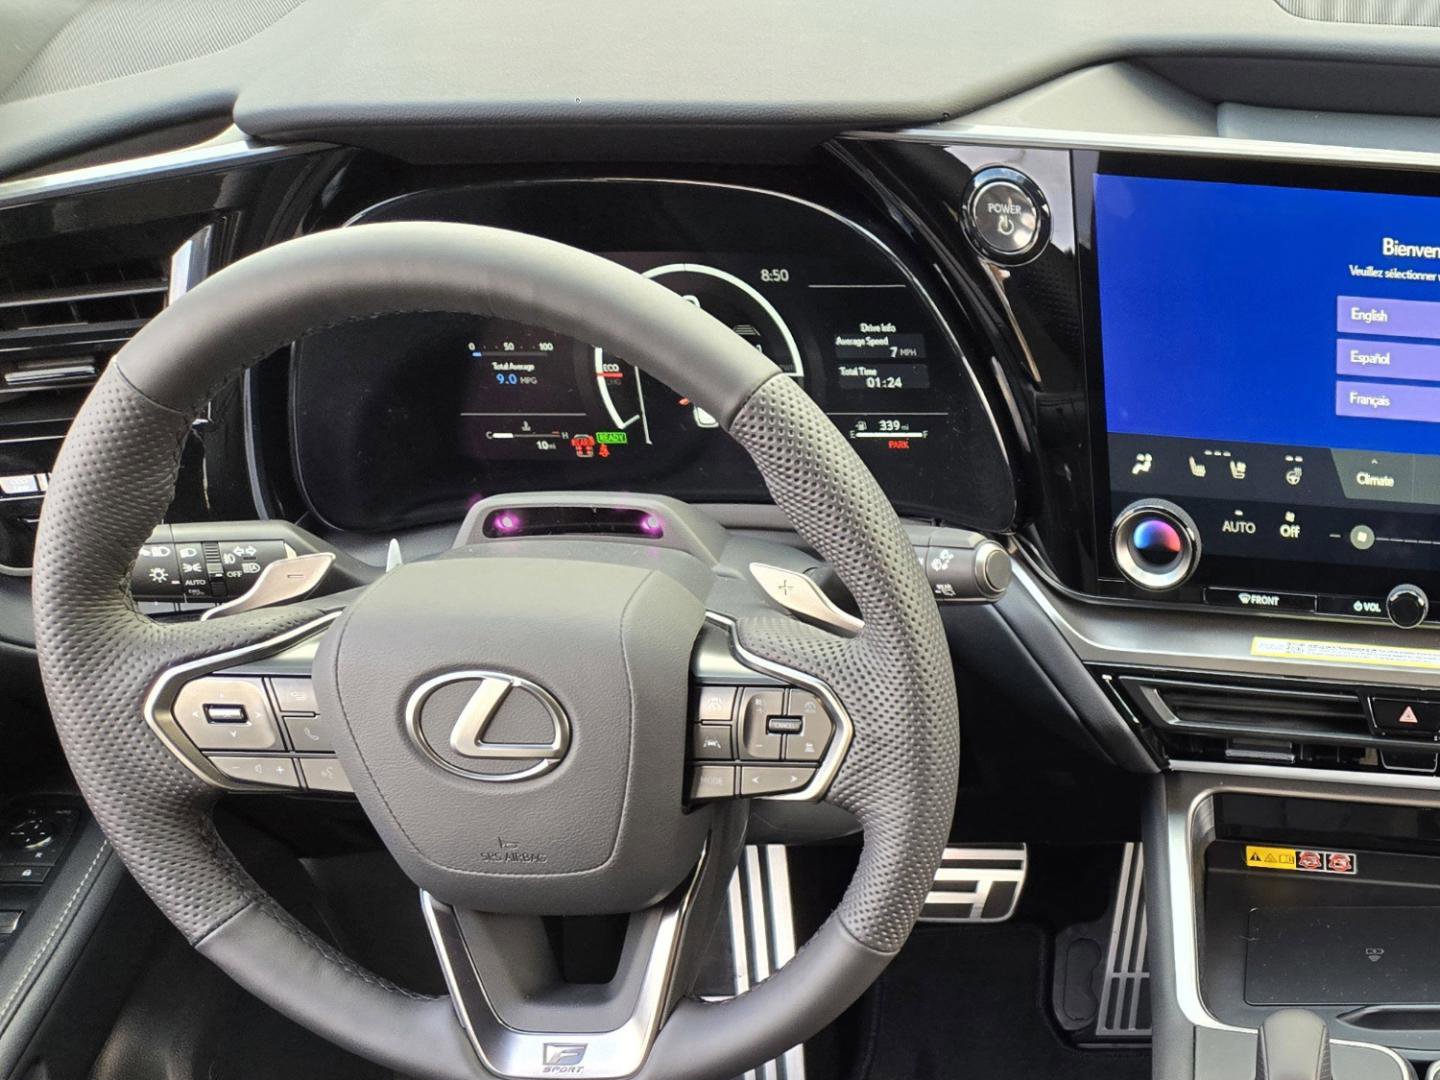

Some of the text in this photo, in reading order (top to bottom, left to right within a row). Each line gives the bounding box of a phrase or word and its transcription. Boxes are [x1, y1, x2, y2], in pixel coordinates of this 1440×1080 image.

[987, 202, 1022, 215] POWER
[759, 268, 790, 282] 8:50
[1348, 264, 1384, 279] Veuillez
[1384, 267, 1437, 282] sélectionner
[1350, 307, 1388, 324] English
[859, 322, 880, 333] Drive
[467, 342, 554, 351] 0 50 100
[834, 336, 889, 348] Average Speed
[889, 346, 917, 358] 7 MPH
[1349, 350, 1391, 367] Español
[492, 362, 536, 373] Total Average
[602, 363, 620, 372] ECO
[838, 366, 878, 376] Total Time
[496, 373, 538, 385] 9.0 MPG
[865, 377, 903, 388] 01:24
[1349, 391, 1391, 408] Français
[878, 419, 900, 431] 339
[599, 433, 625, 443] READY
[887, 440, 910, 449] PARK
[1355, 471, 1395, 488] Climate
[1222, 519, 1257, 535] AUTO
[1279, 524, 1301, 539] Off
[226, 570, 243, 578] OFF
[1250, 594, 1280, 607] FRONT
[1363, 602, 1382, 614] VOL
[480, 852, 502, 863] SRS
[542, 1065, 585, 1074] SPORT
